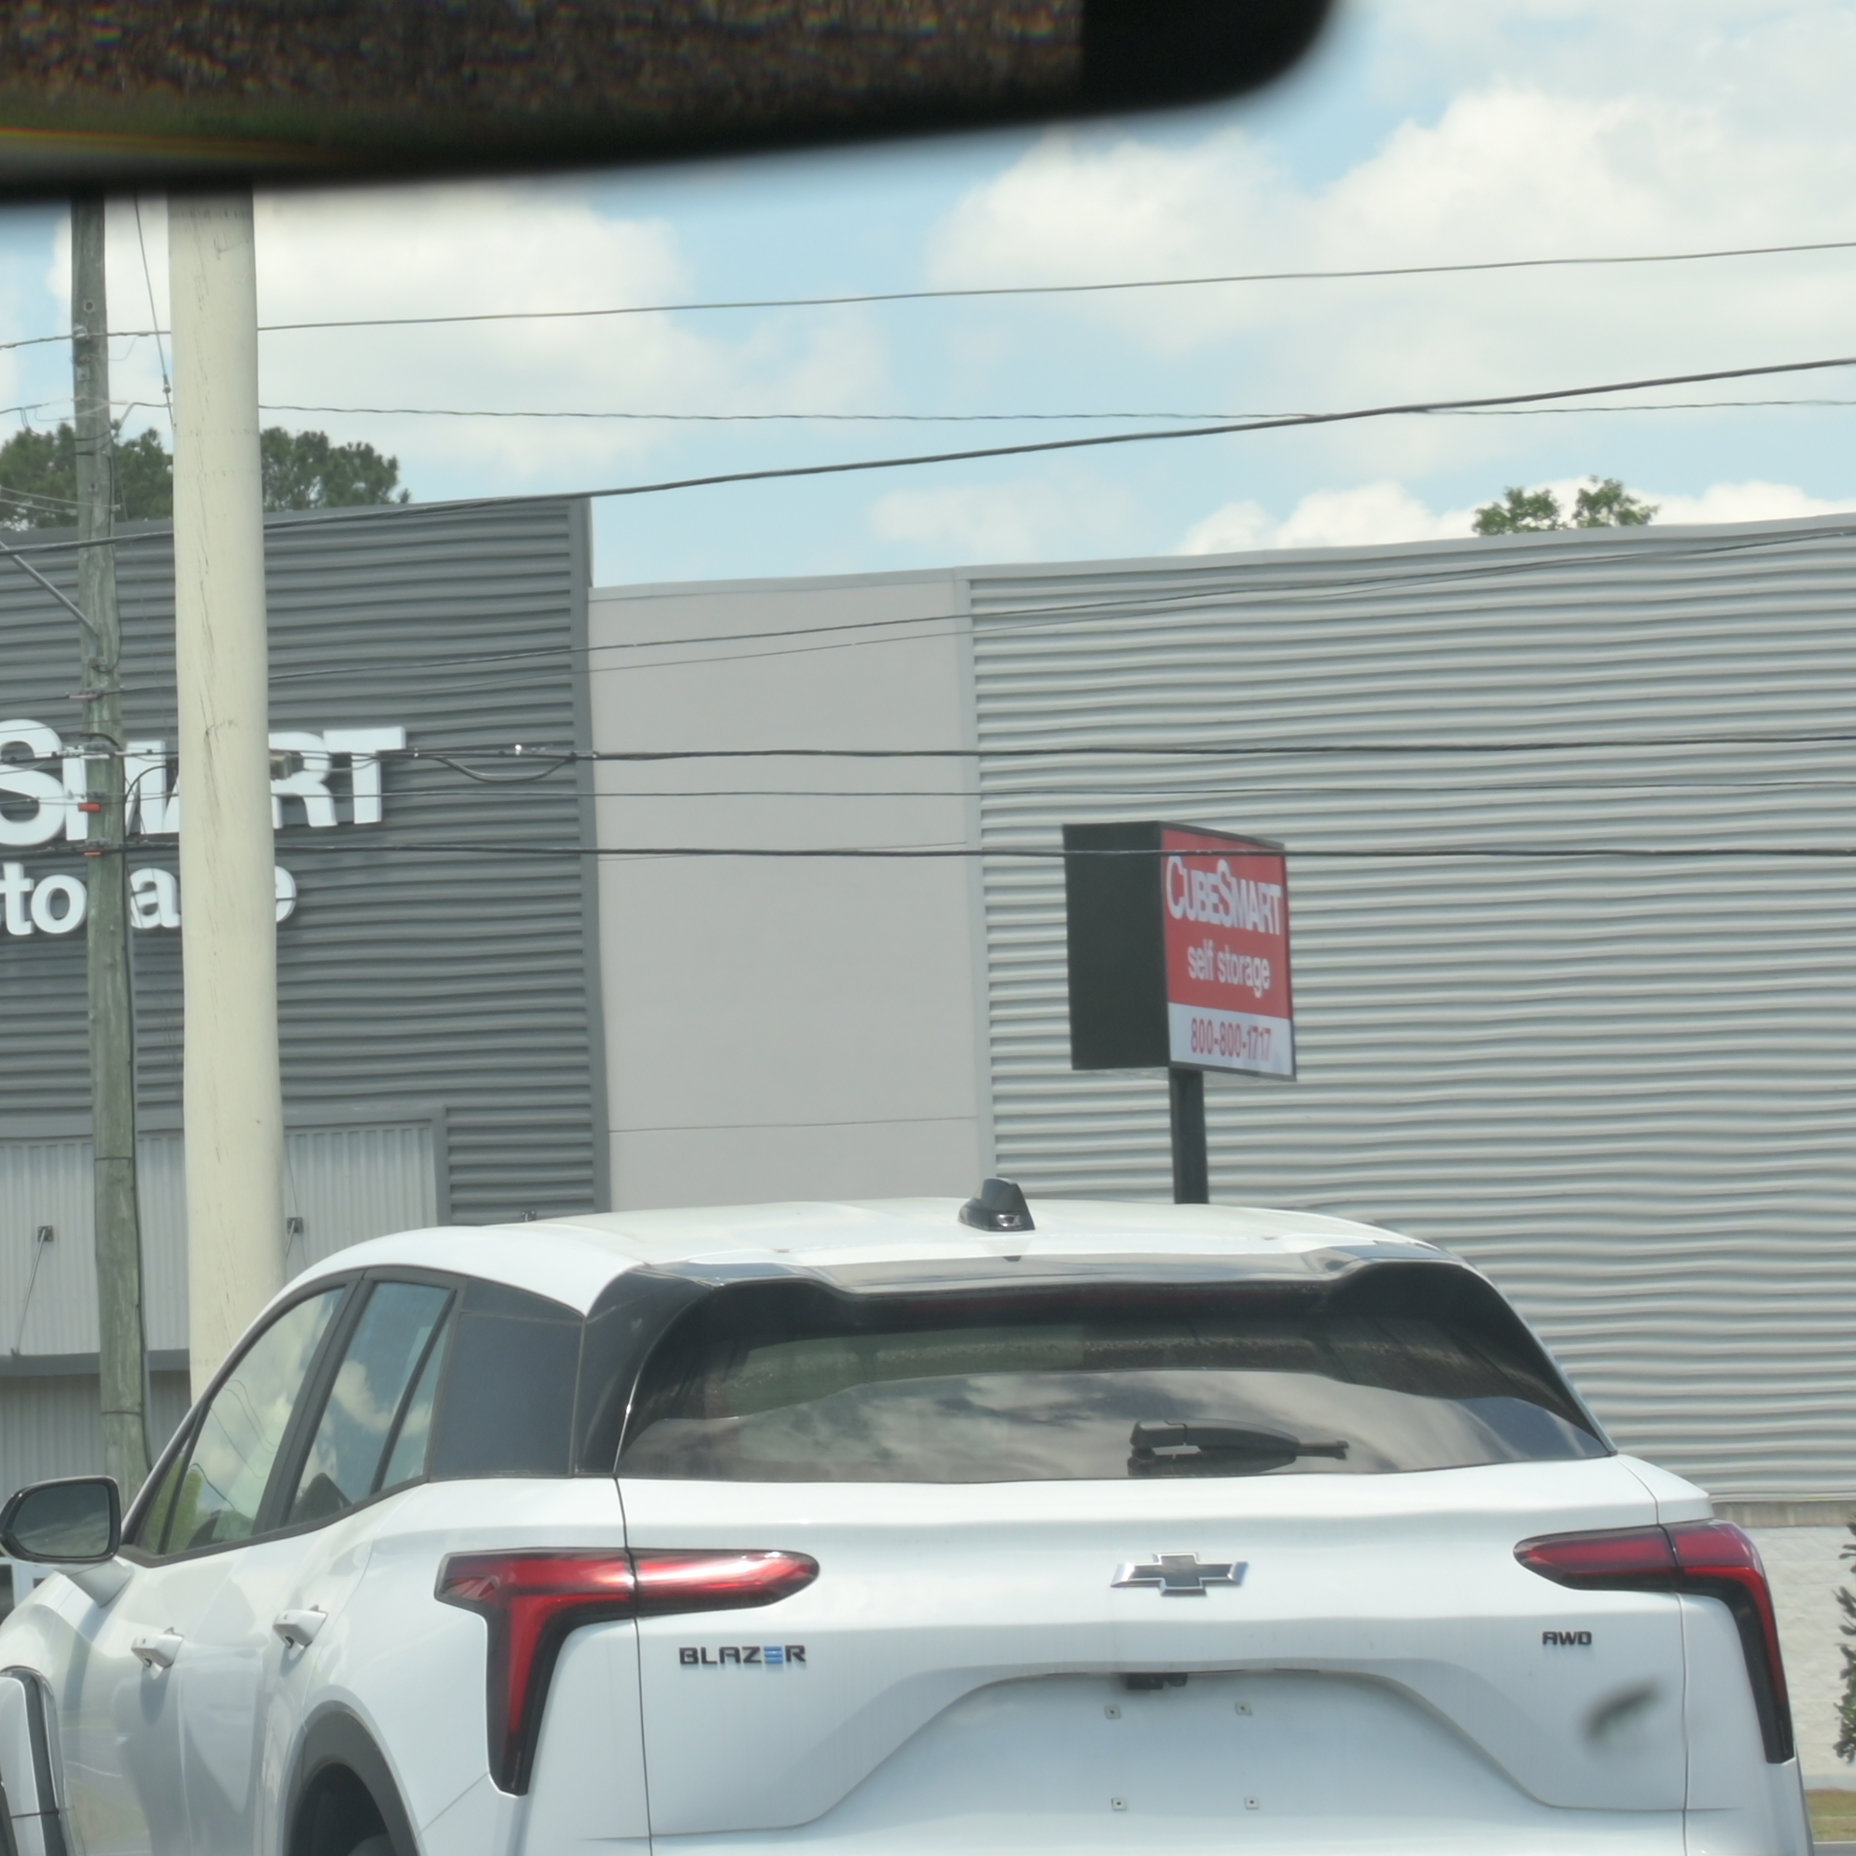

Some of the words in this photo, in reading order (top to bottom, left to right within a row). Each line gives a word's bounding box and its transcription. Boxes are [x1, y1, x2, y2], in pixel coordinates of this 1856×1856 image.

[1187, 939, 1214, 982] self
[1217, 944, 1271, 998] storage
[1542, 1630, 1592, 1646] AWD
[679, 1644, 806, 1665] BLAZER
